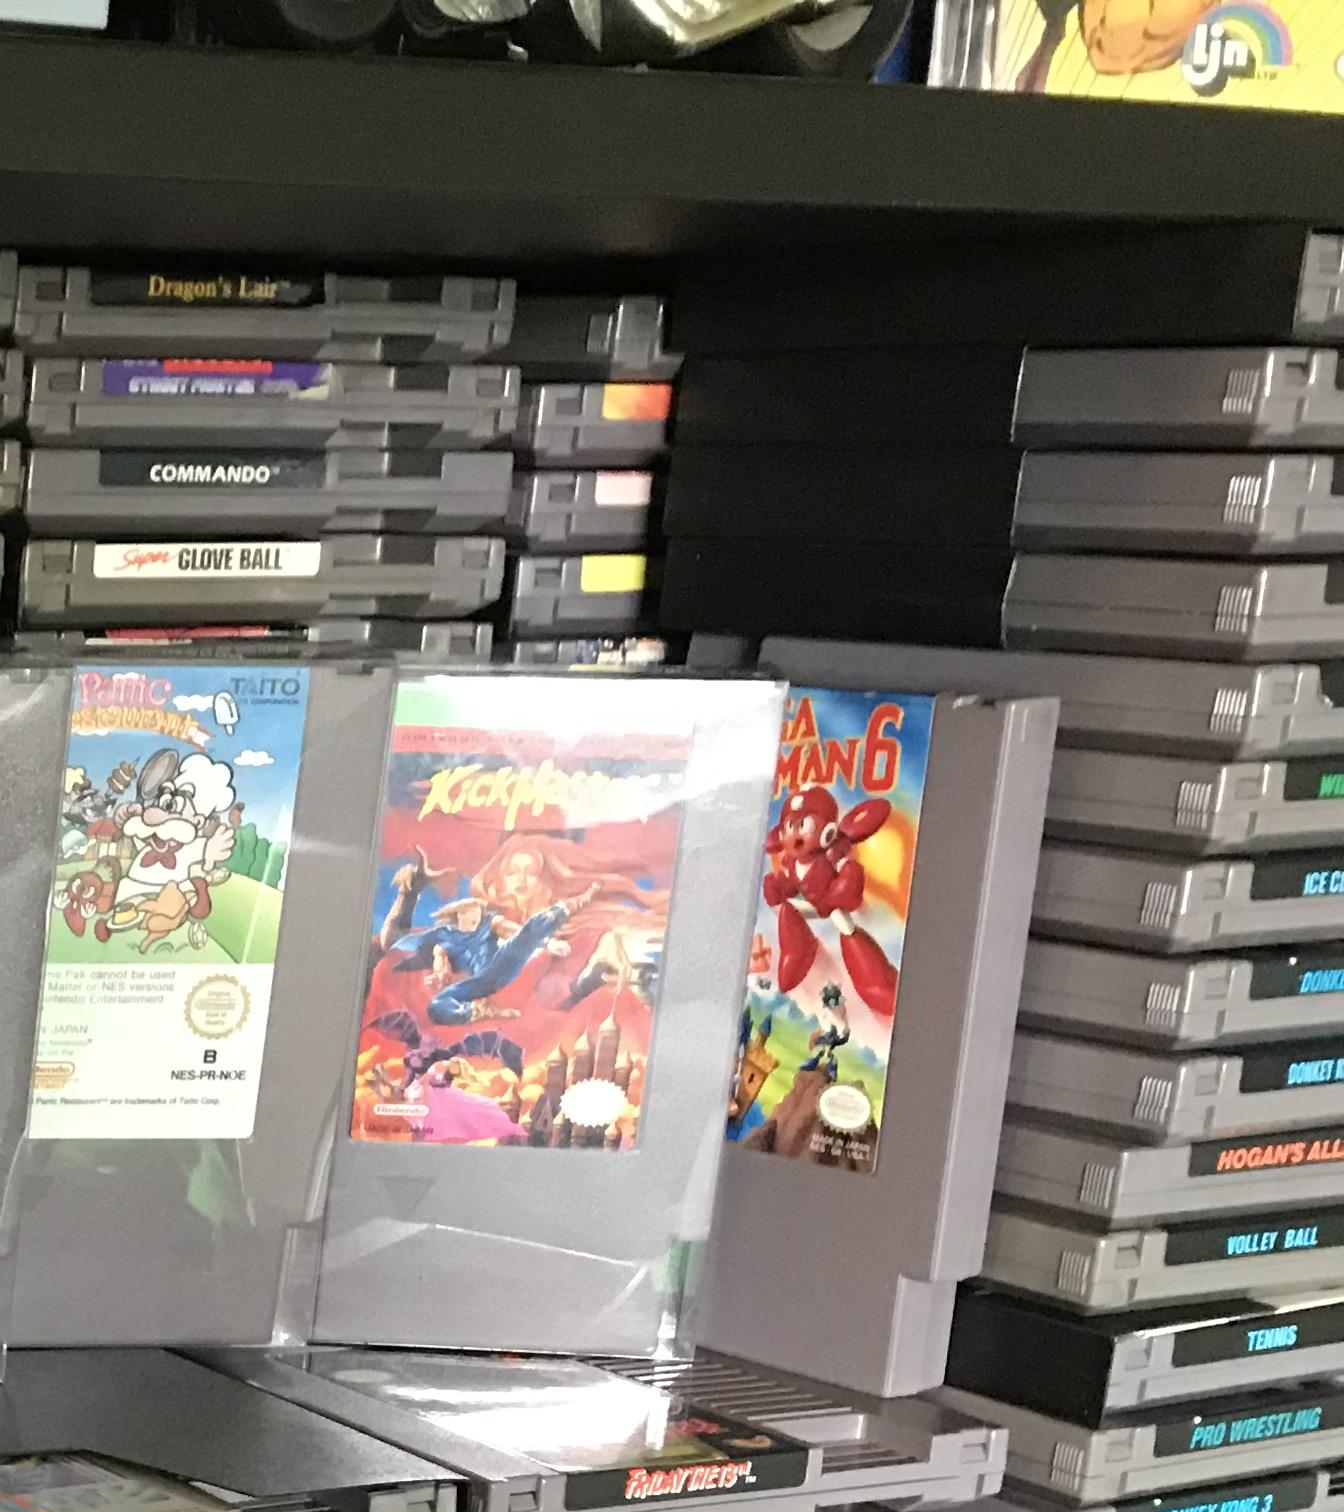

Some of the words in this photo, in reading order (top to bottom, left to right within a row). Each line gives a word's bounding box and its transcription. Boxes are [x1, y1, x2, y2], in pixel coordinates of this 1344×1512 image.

[148, 276, 233, 300] Dragon's
[238, 278, 278, 299] Lair
[149, 465, 271, 484] COMMANDO
[178, 548, 233, 570] GLOVE
[237, 548, 283, 570] BALL
[231, 677, 300, 697] TAITO
[861, 702, 905, 793] 6
[203, 1049, 217, 1064] B
[1217, 1143, 1305, 1173] HOGAN'S
[1227, 1231, 1276, 1255] VOLLEY
[1284, 1227, 1318, 1249] BALL
[1247, 1325, 1298, 1352] TENNIS
[1190, 1421, 1225, 1450] PRO
[1228, 1407, 1323, 1445] WRESTLING
